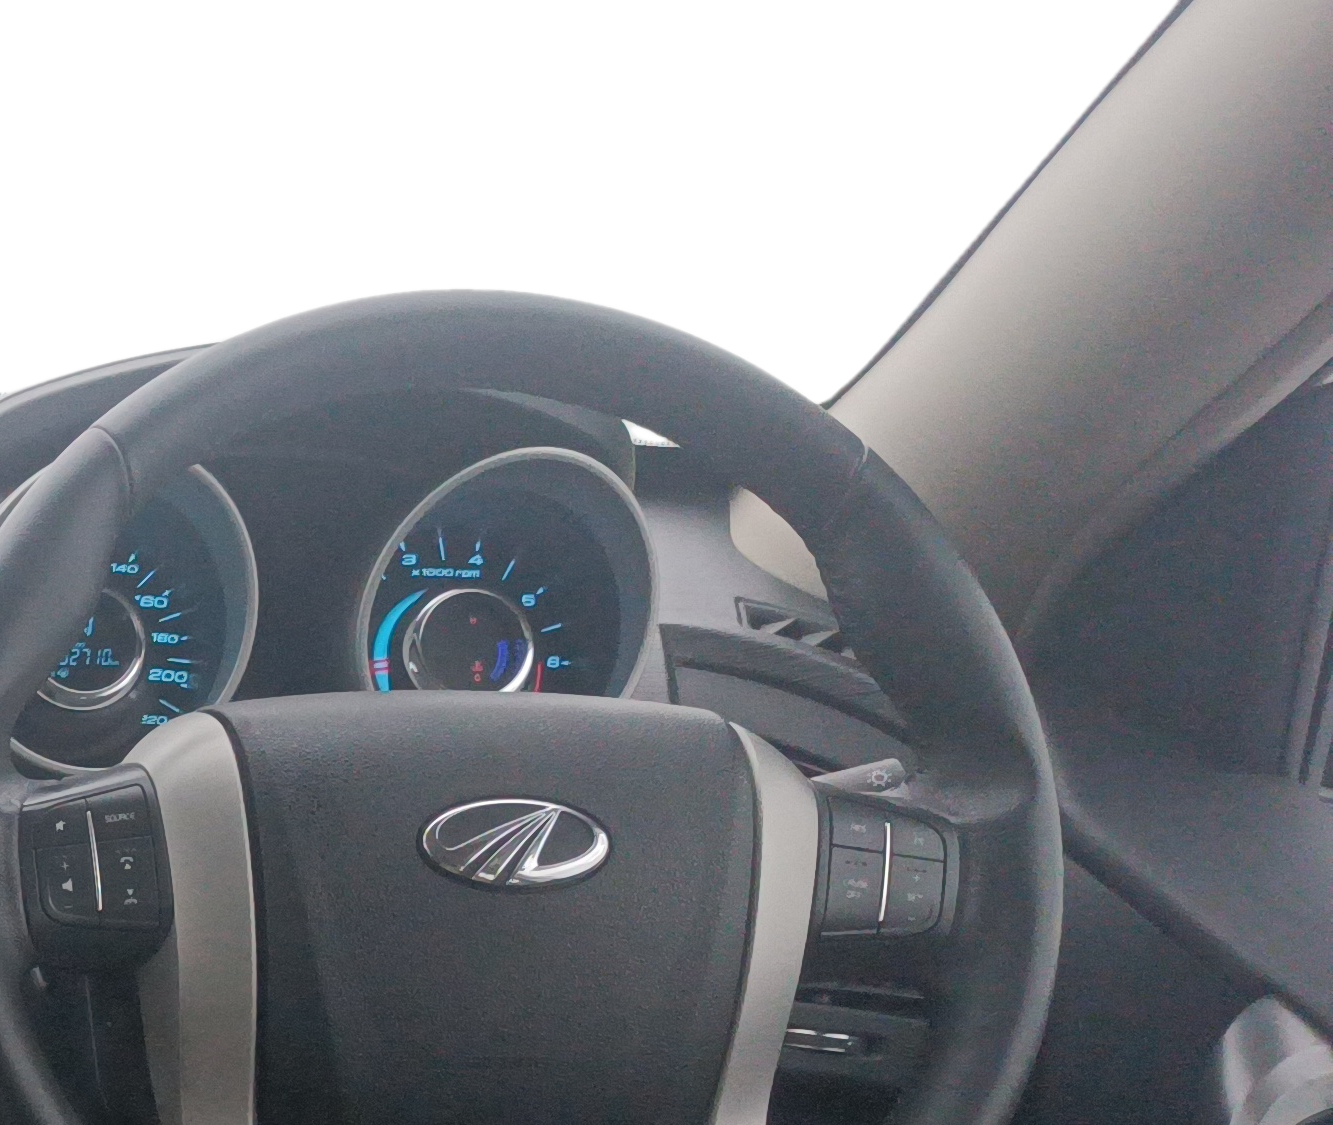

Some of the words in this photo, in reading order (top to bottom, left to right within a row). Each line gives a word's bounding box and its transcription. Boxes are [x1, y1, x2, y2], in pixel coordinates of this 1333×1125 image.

[401, 553, 417, 566] 3
[467, 554, 483, 566] 4
[110, 562, 140, 574] 140
[148, 668, 188, 682] 200
[104, 811, 136, 823] SOURCE
